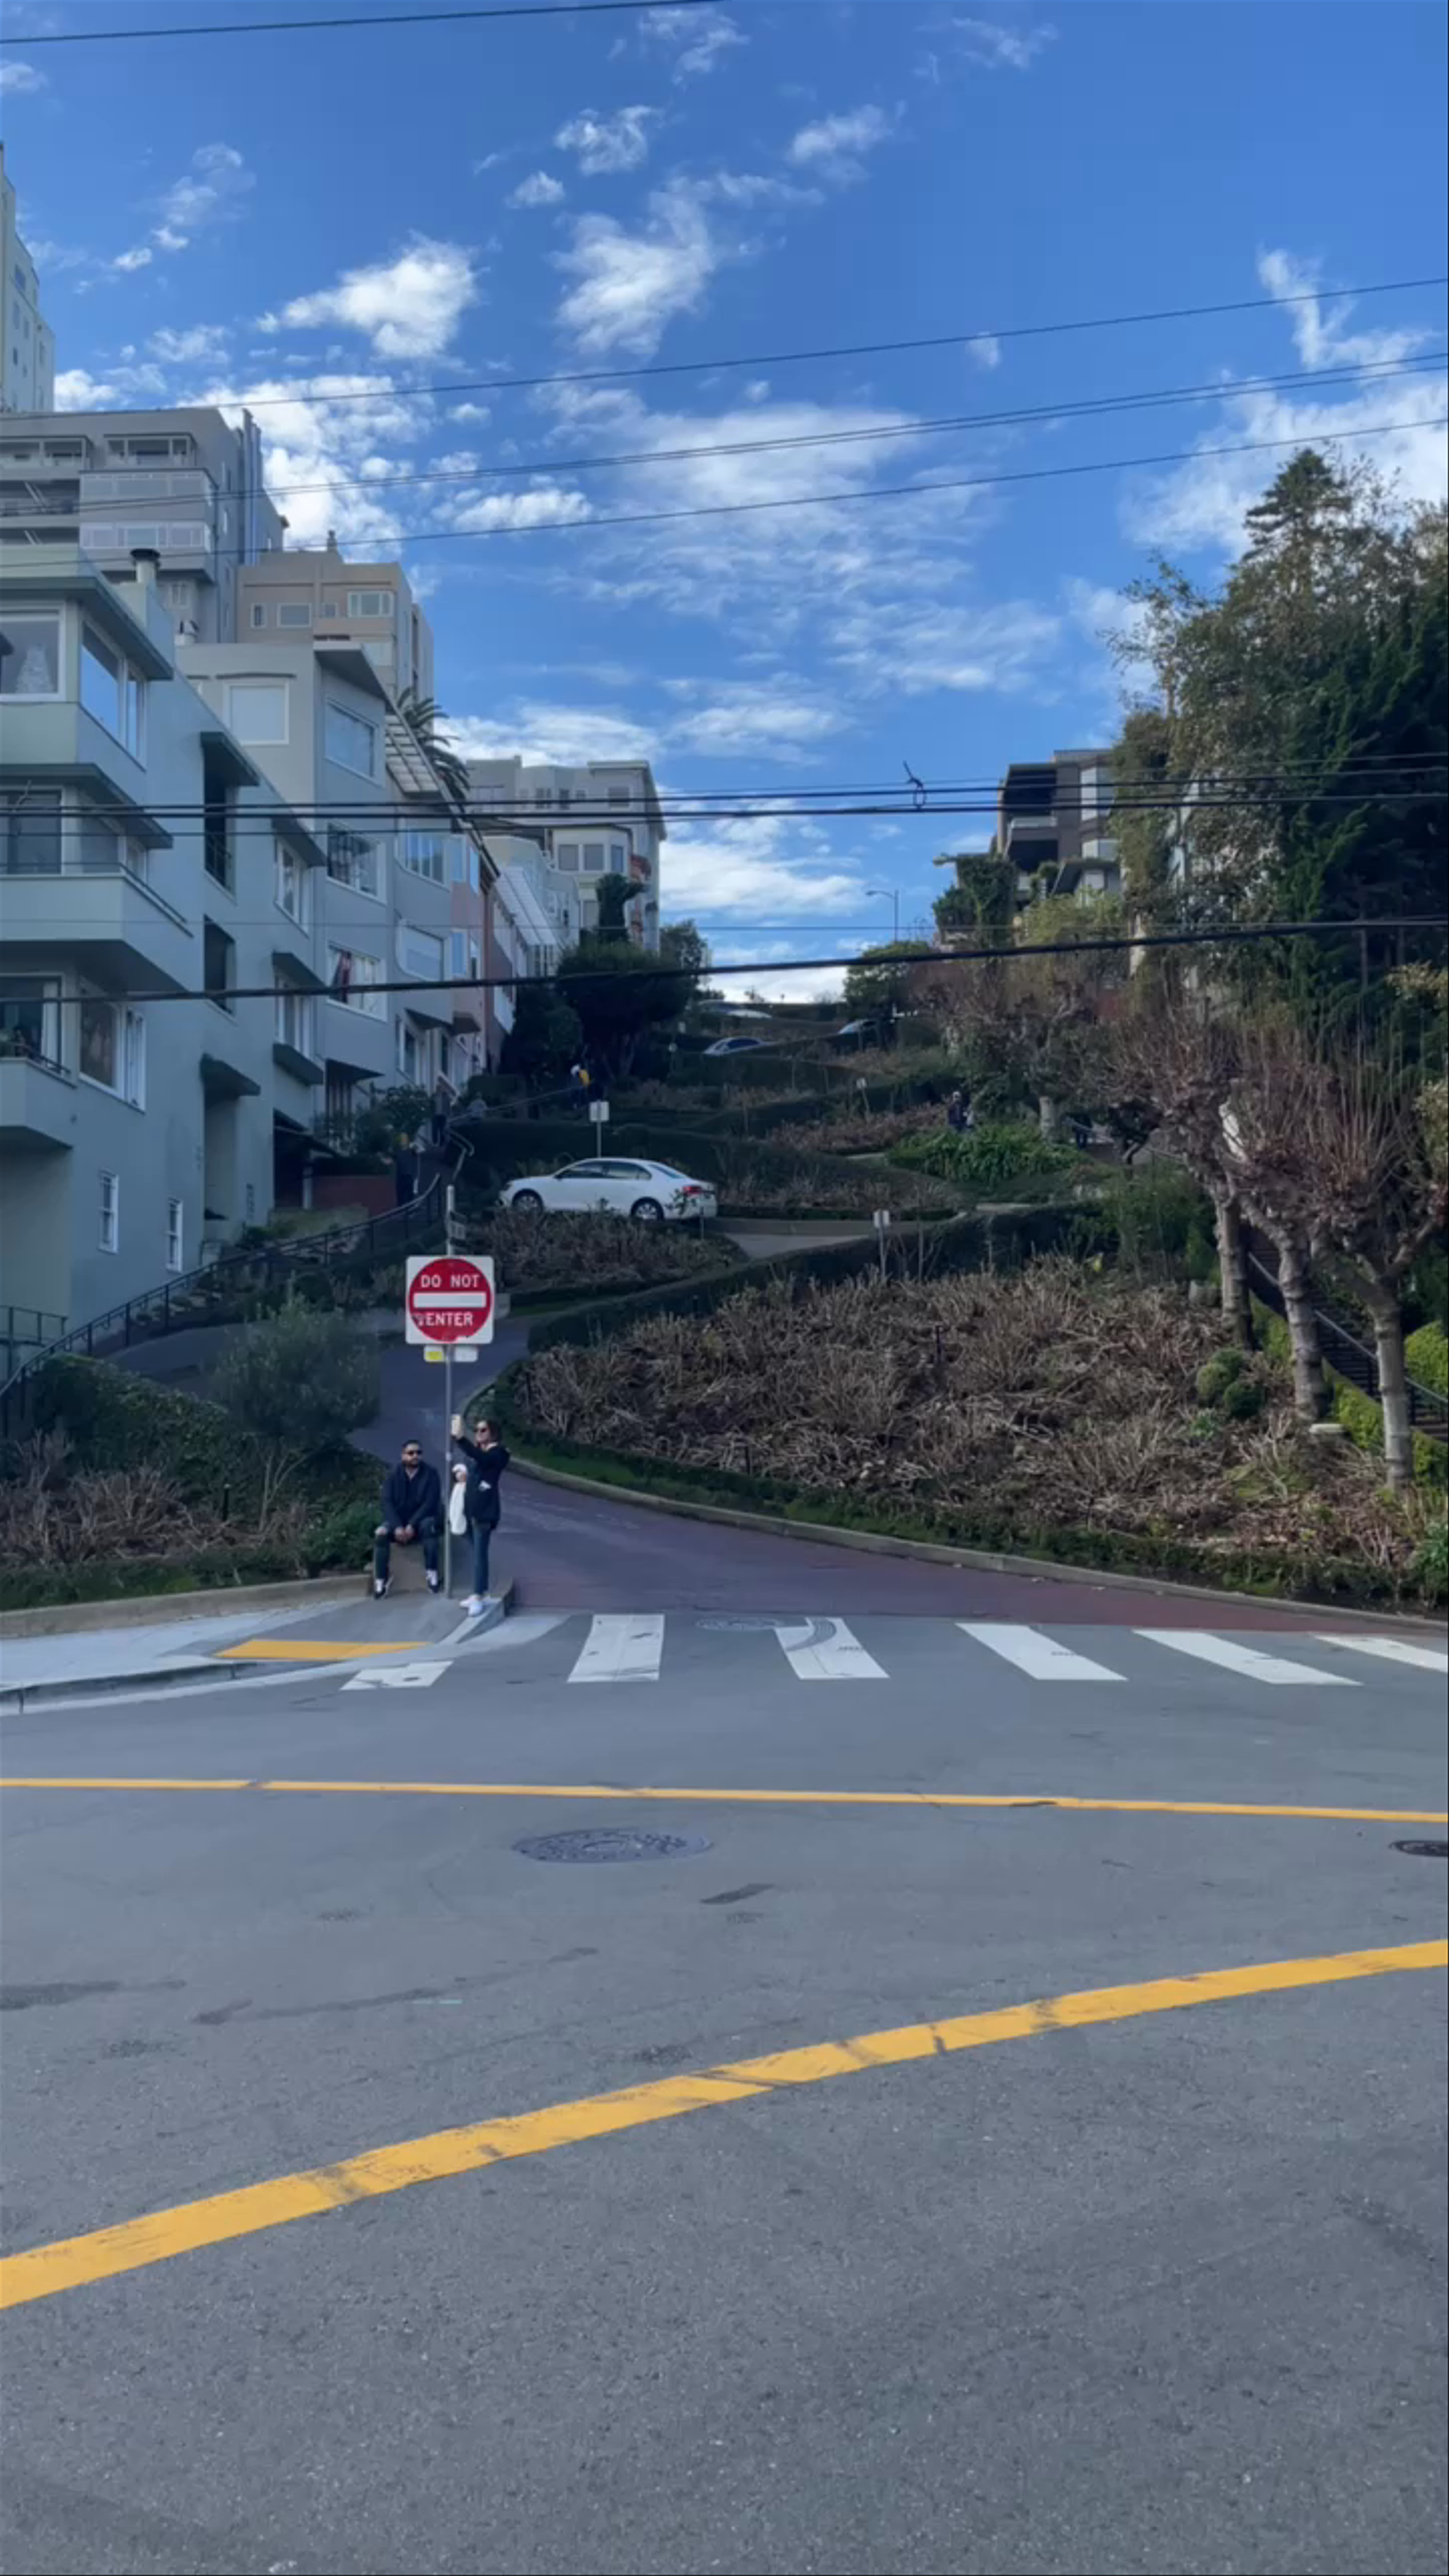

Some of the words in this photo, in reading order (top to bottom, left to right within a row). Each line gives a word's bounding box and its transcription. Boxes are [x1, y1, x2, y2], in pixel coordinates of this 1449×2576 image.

[421, 1274, 441, 1288] DO
[451, 1274, 479, 1288] NOT
[426, 1312, 473, 1326] ENTER
